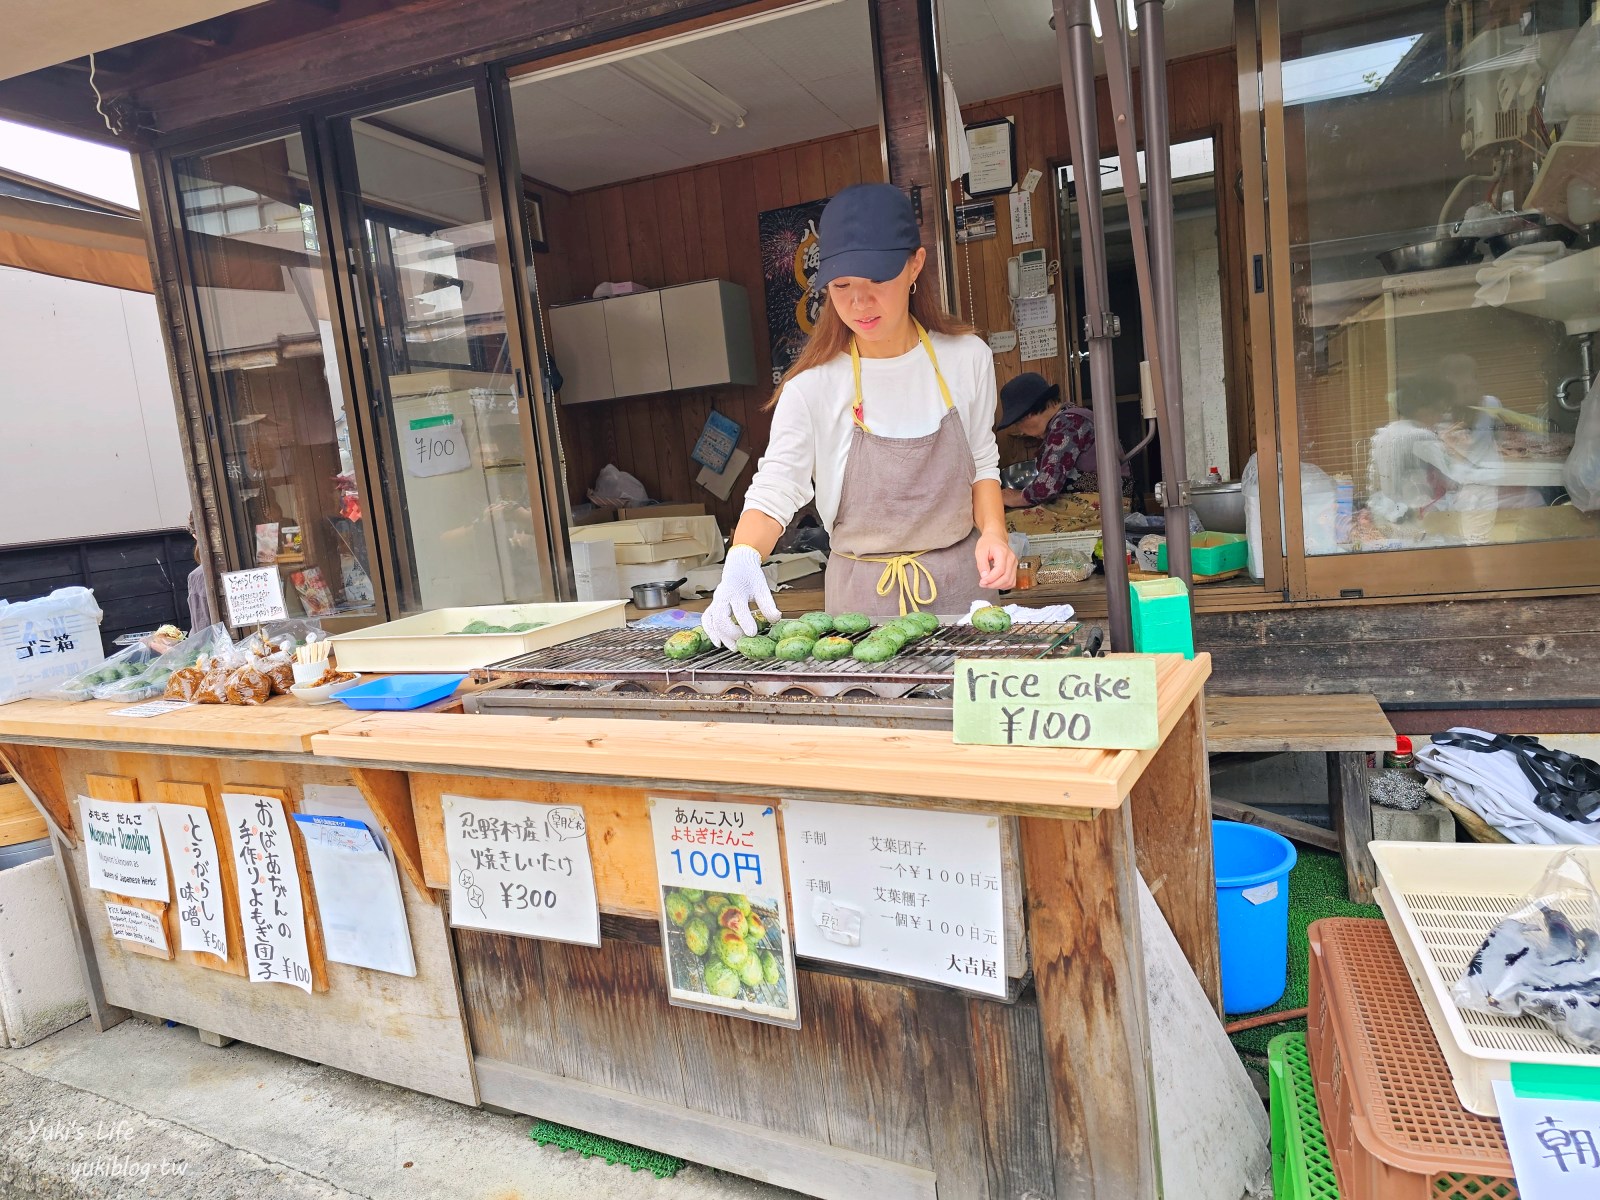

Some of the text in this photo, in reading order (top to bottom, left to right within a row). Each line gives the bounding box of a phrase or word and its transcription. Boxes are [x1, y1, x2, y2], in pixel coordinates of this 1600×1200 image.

[415, 437, 455, 463] ¥100
[16, 633, 74, 660] ゴミ箱
[967, 667, 1040, 702] rice
[1000, 707, 1092, 744] ¥100
[88, 809, 110, 823] よもぎ
[674, 807, 745, 828] あんこ入り
[670, 825, 754, 848] よもぎだんご
[800, 830, 827, 846] 手制
[188, 813, 215, 922] とうがらし
[256, 799, 292, 939] おばあちゃんの
[471, 848, 573, 876] 焼きしいたけ
[670, 848, 763, 885] 100円
[180, 881, 201, 927] 味噌
[238, 819, 278, 980] 手作りよもぎ団子
[500, 882, 557, 910] ¥300
[203, 929, 226, 955] ¥500
[282, 956, 310, 985] ¥100
[945, 953, 998, 980] 大吉屋
[1535, 1116, 1600, 1172] 朝
